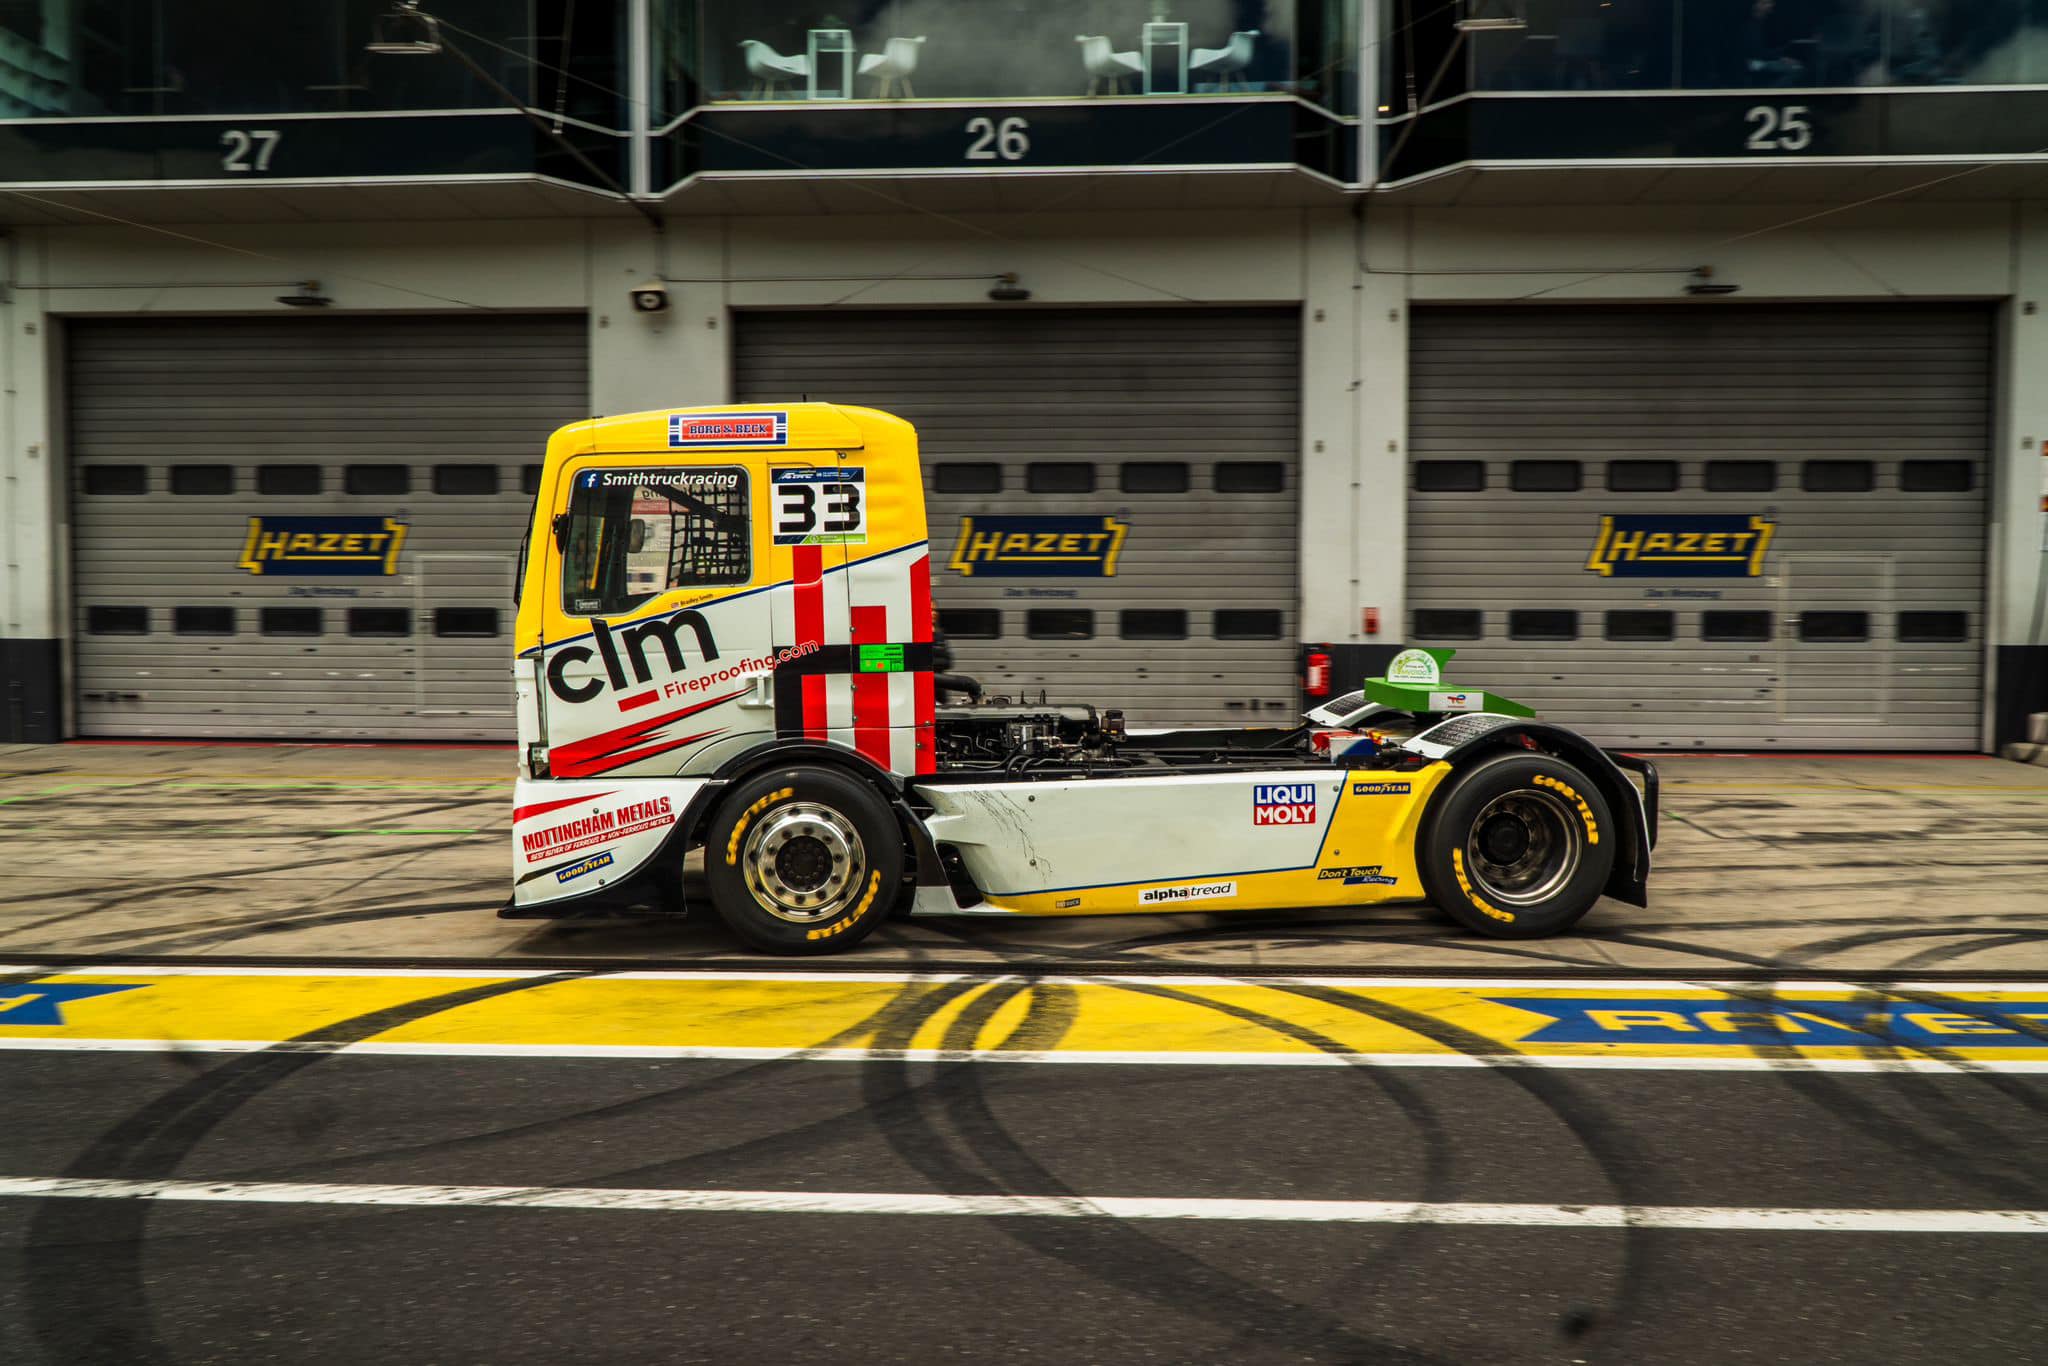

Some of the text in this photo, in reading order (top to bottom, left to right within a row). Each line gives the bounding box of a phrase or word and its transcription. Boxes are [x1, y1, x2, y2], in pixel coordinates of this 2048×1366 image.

[964, 116, 1030, 160] 26
[1744, 105, 1812, 150] 25
[220, 129, 282, 172] 27
[689, 423, 768, 434] BORG & BECK
[602, 471, 739, 488] Smithtruckracing
[778, 483, 861, 532] 33
[256, 531, 391, 560] HAZET
[967, 531, 1110, 561] HAZET
[1606, 530, 1757, 561] HAZET
[547, 609, 720, 703] clm
[663, 639, 820, 699] Fireproofing.com
[1256, 785, 1313, 804] LIQUI
[1355, 783, 1409, 794] GOODYEAR
[522, 796, 671, 851] MOTTINGHAM METALS
[1256, 805, 1315, 824] MOLY
[558, 855, 611, 881] GOODYEAR
[1319, 868, 1380, 879] Don't Touch
